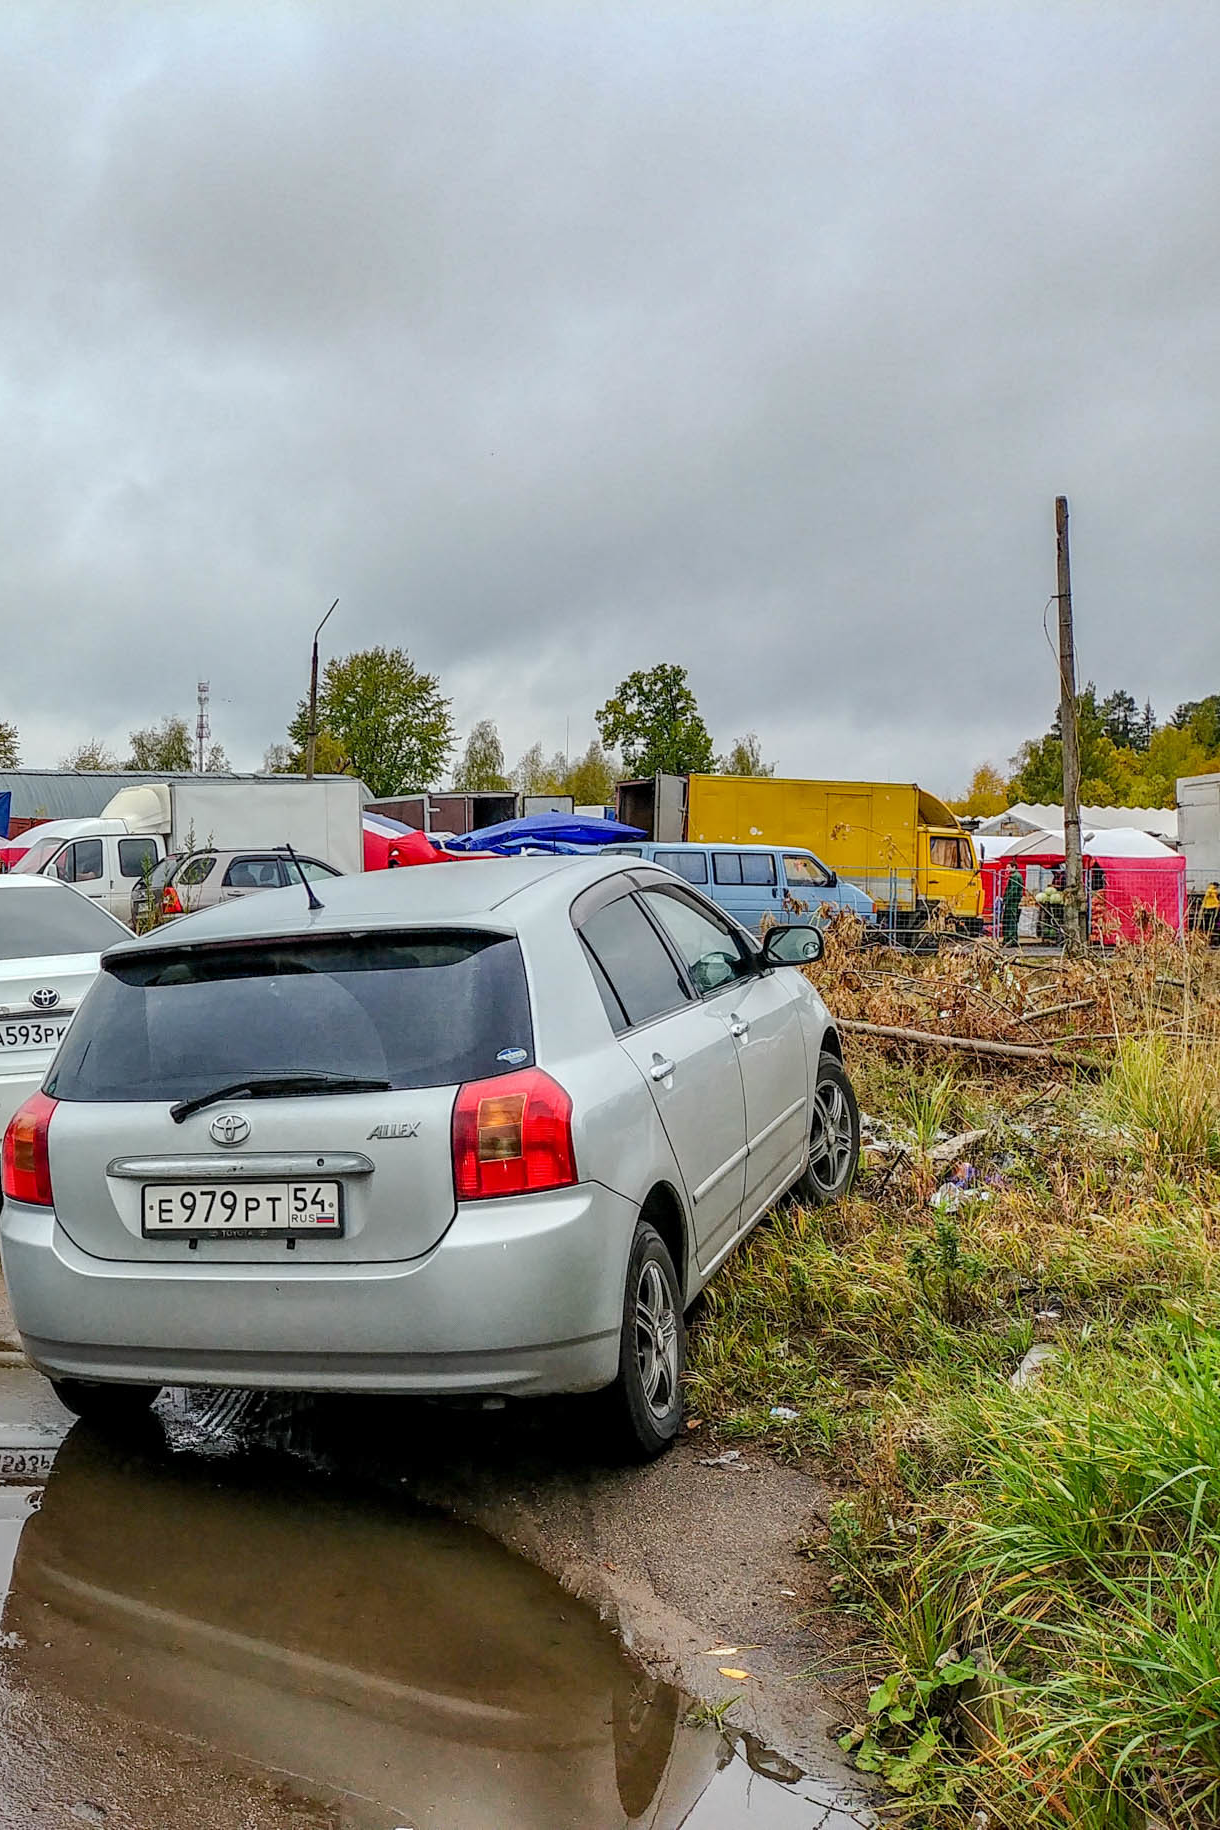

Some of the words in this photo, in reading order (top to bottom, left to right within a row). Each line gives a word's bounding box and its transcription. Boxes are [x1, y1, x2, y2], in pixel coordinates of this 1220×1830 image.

[366, 1121, 422, 1140] ALLEX
[158, 1190, 282, 1223] Е979РТ
[293, 1187, 326, 1212] 54
[291, 1213, 315, 1223] RUS
[221, 1229, 253, 1237] TOYOTA
